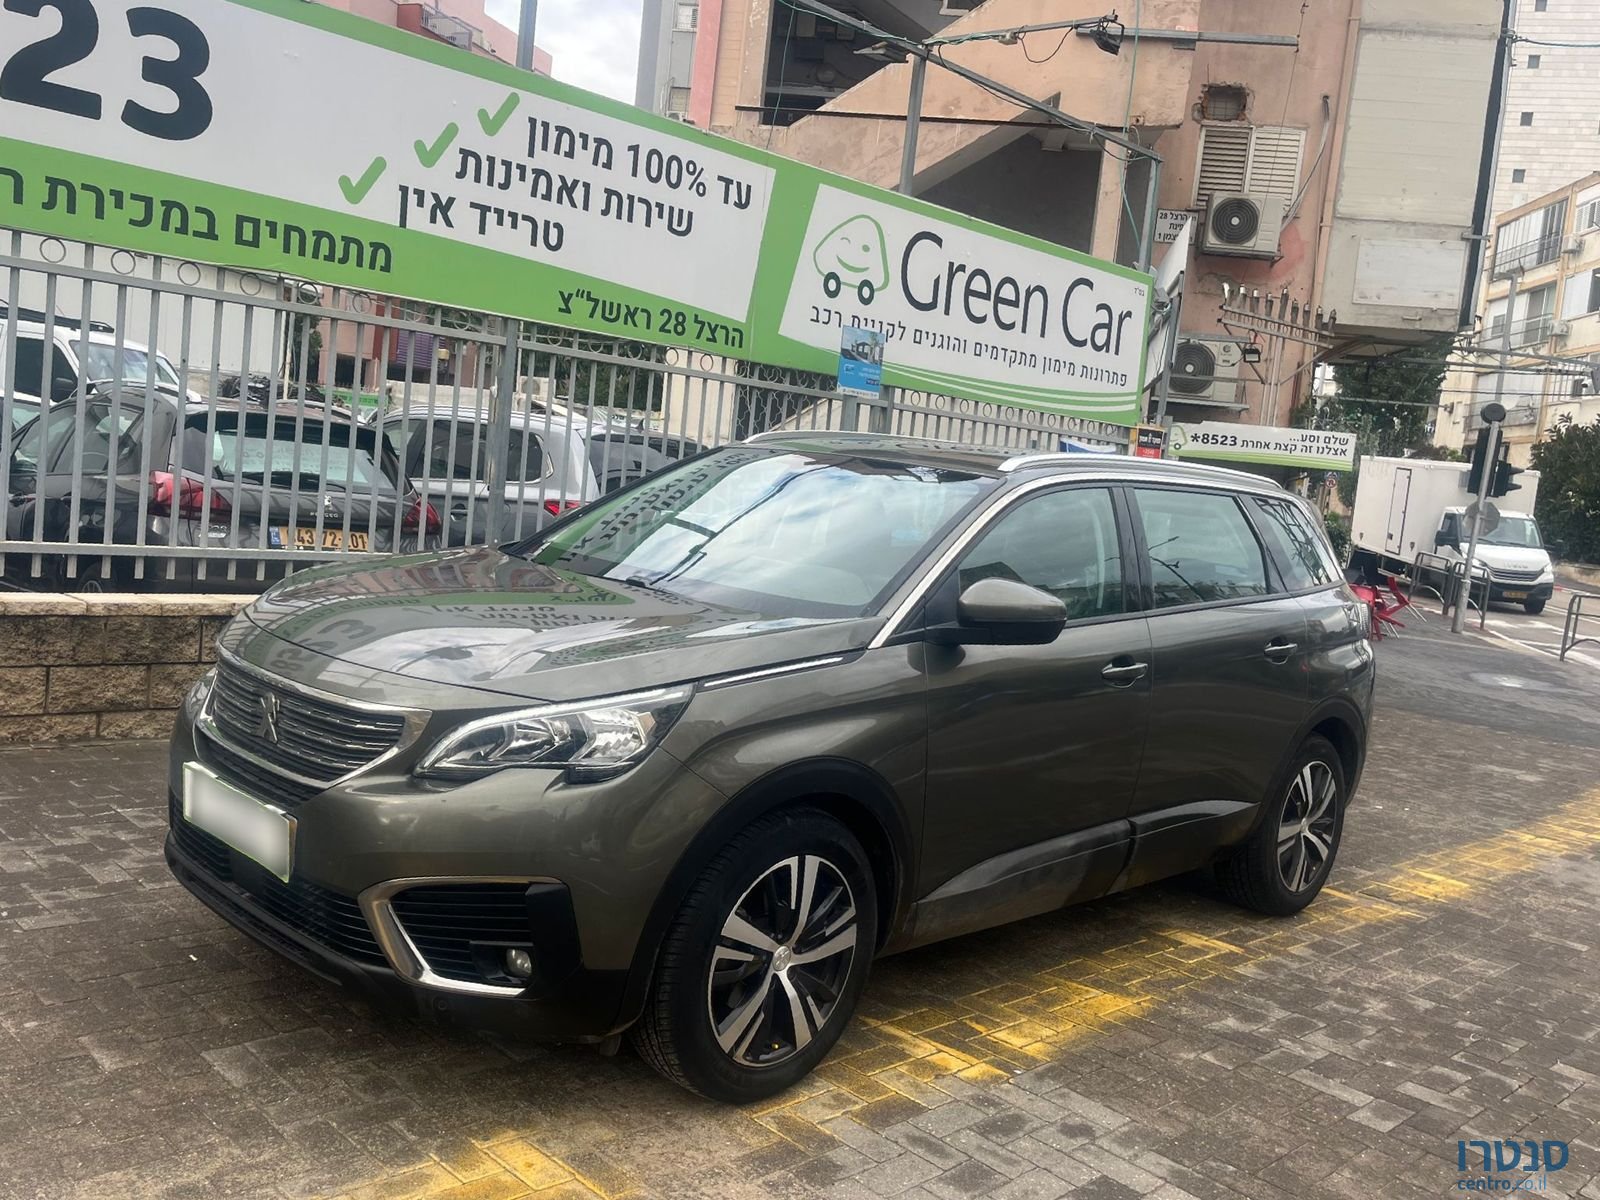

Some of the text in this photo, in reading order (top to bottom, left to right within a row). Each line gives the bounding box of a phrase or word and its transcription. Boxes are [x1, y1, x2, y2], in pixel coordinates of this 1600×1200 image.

[527, 116, 752, 210] עד 100% מימון
[455, 147, 694, 237] שירות ואמינות
[41, 175, 219, 241] במכירת
[398, 184, 564, 252] טרייד אין
[235, 213, 392, 273] מתמחים
[900, 231, 1132, 356] Green Car
[658, 308, 686, 336] 28
[810, 305, 843, 328] רכב
[693, 313, 744, 348] הרצל
[913, 328, 967, 354] והוגנים
[974, 341, 1037, 368] מתקדמים
[1042, 356, 1076, 375] מימון
[1080, 364, 1127, 387] פתרונות
[1240, 439, 1270, 450] אחרת
[1274, 441, 1297, 454] קצת
[1300, 444, 1313, 454] זה
[1316, 444, 1348, 457] אצלנו
[1323, 433, 1349, 446] שלם
